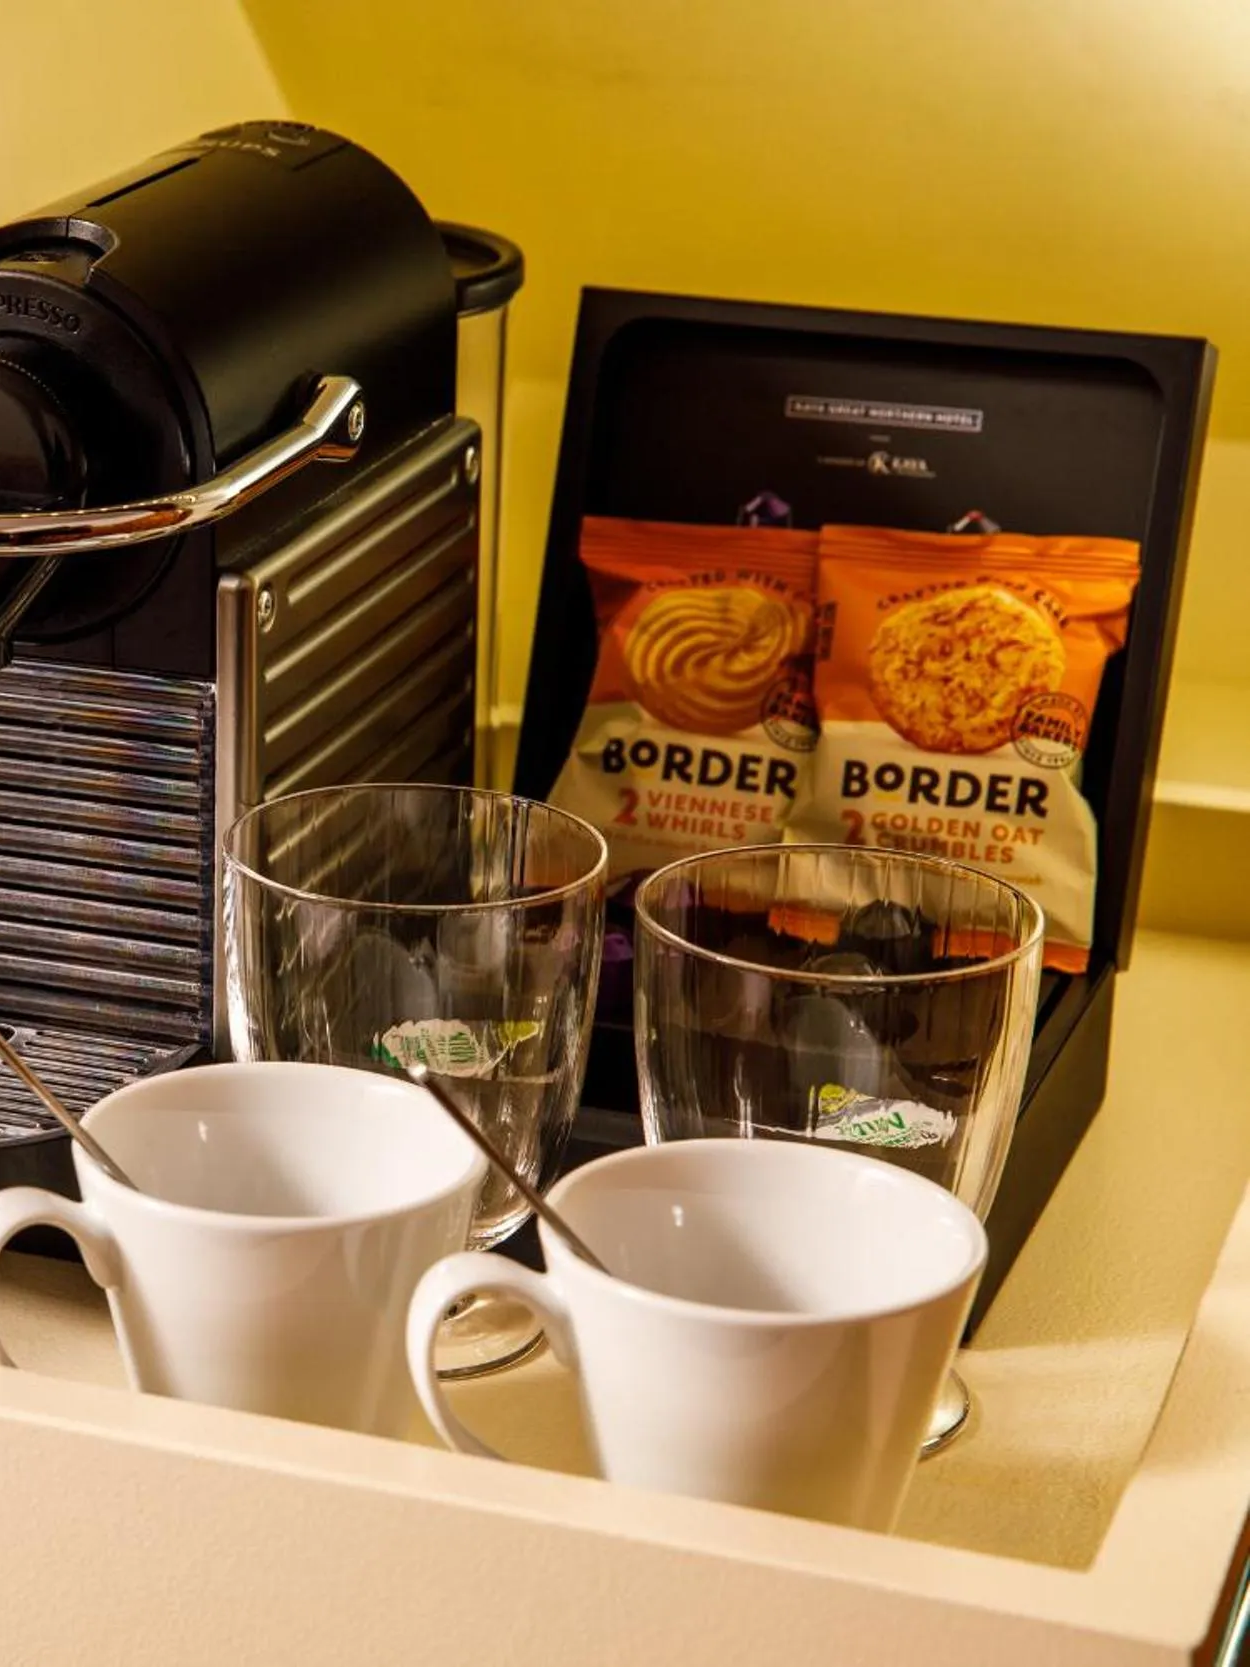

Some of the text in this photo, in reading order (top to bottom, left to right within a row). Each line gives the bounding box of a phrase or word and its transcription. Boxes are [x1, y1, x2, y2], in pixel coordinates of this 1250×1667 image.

[602, 737, 798, 800] BORDER
[614, 787, 774, 827] 2 VIENNESE
[841, 759, 1049, 819] BORDER
[646, 811, 747, 841] WHIRLS
[840, 808, 1046, 846] 2 GOLDEN OAT
[875, 831, 1017, 864] CRUMBLES
